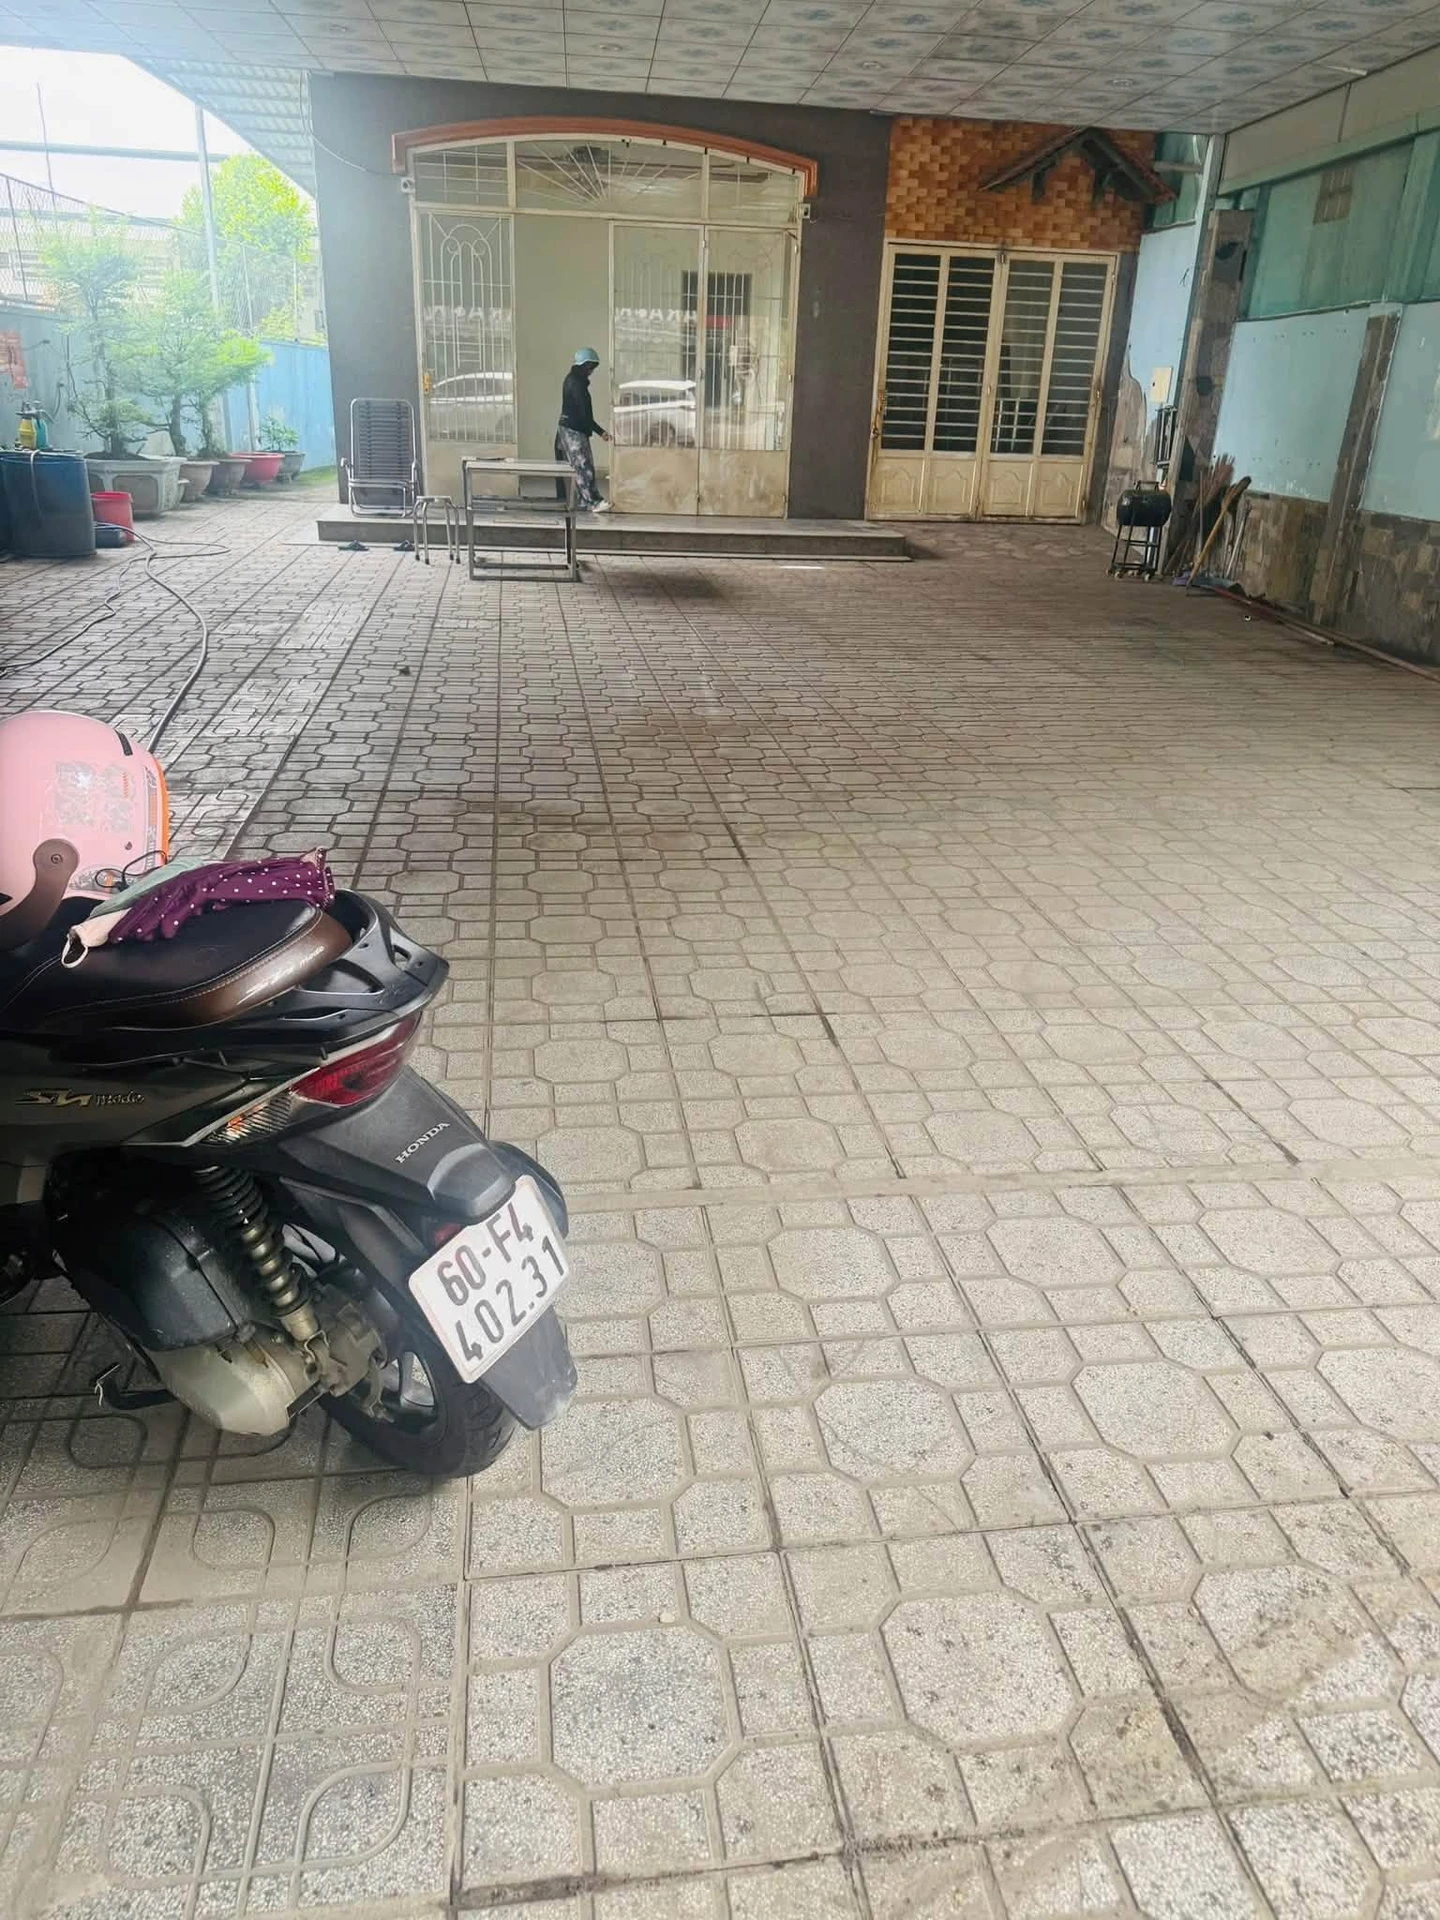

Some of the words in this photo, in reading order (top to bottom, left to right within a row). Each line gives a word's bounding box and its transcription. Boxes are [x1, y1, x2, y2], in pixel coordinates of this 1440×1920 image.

[395, 1122, 451, 1163] HONDA
[437, 1202, 534, 1306] 60-F4
[455, 1235, 564, 1362] 402.31
